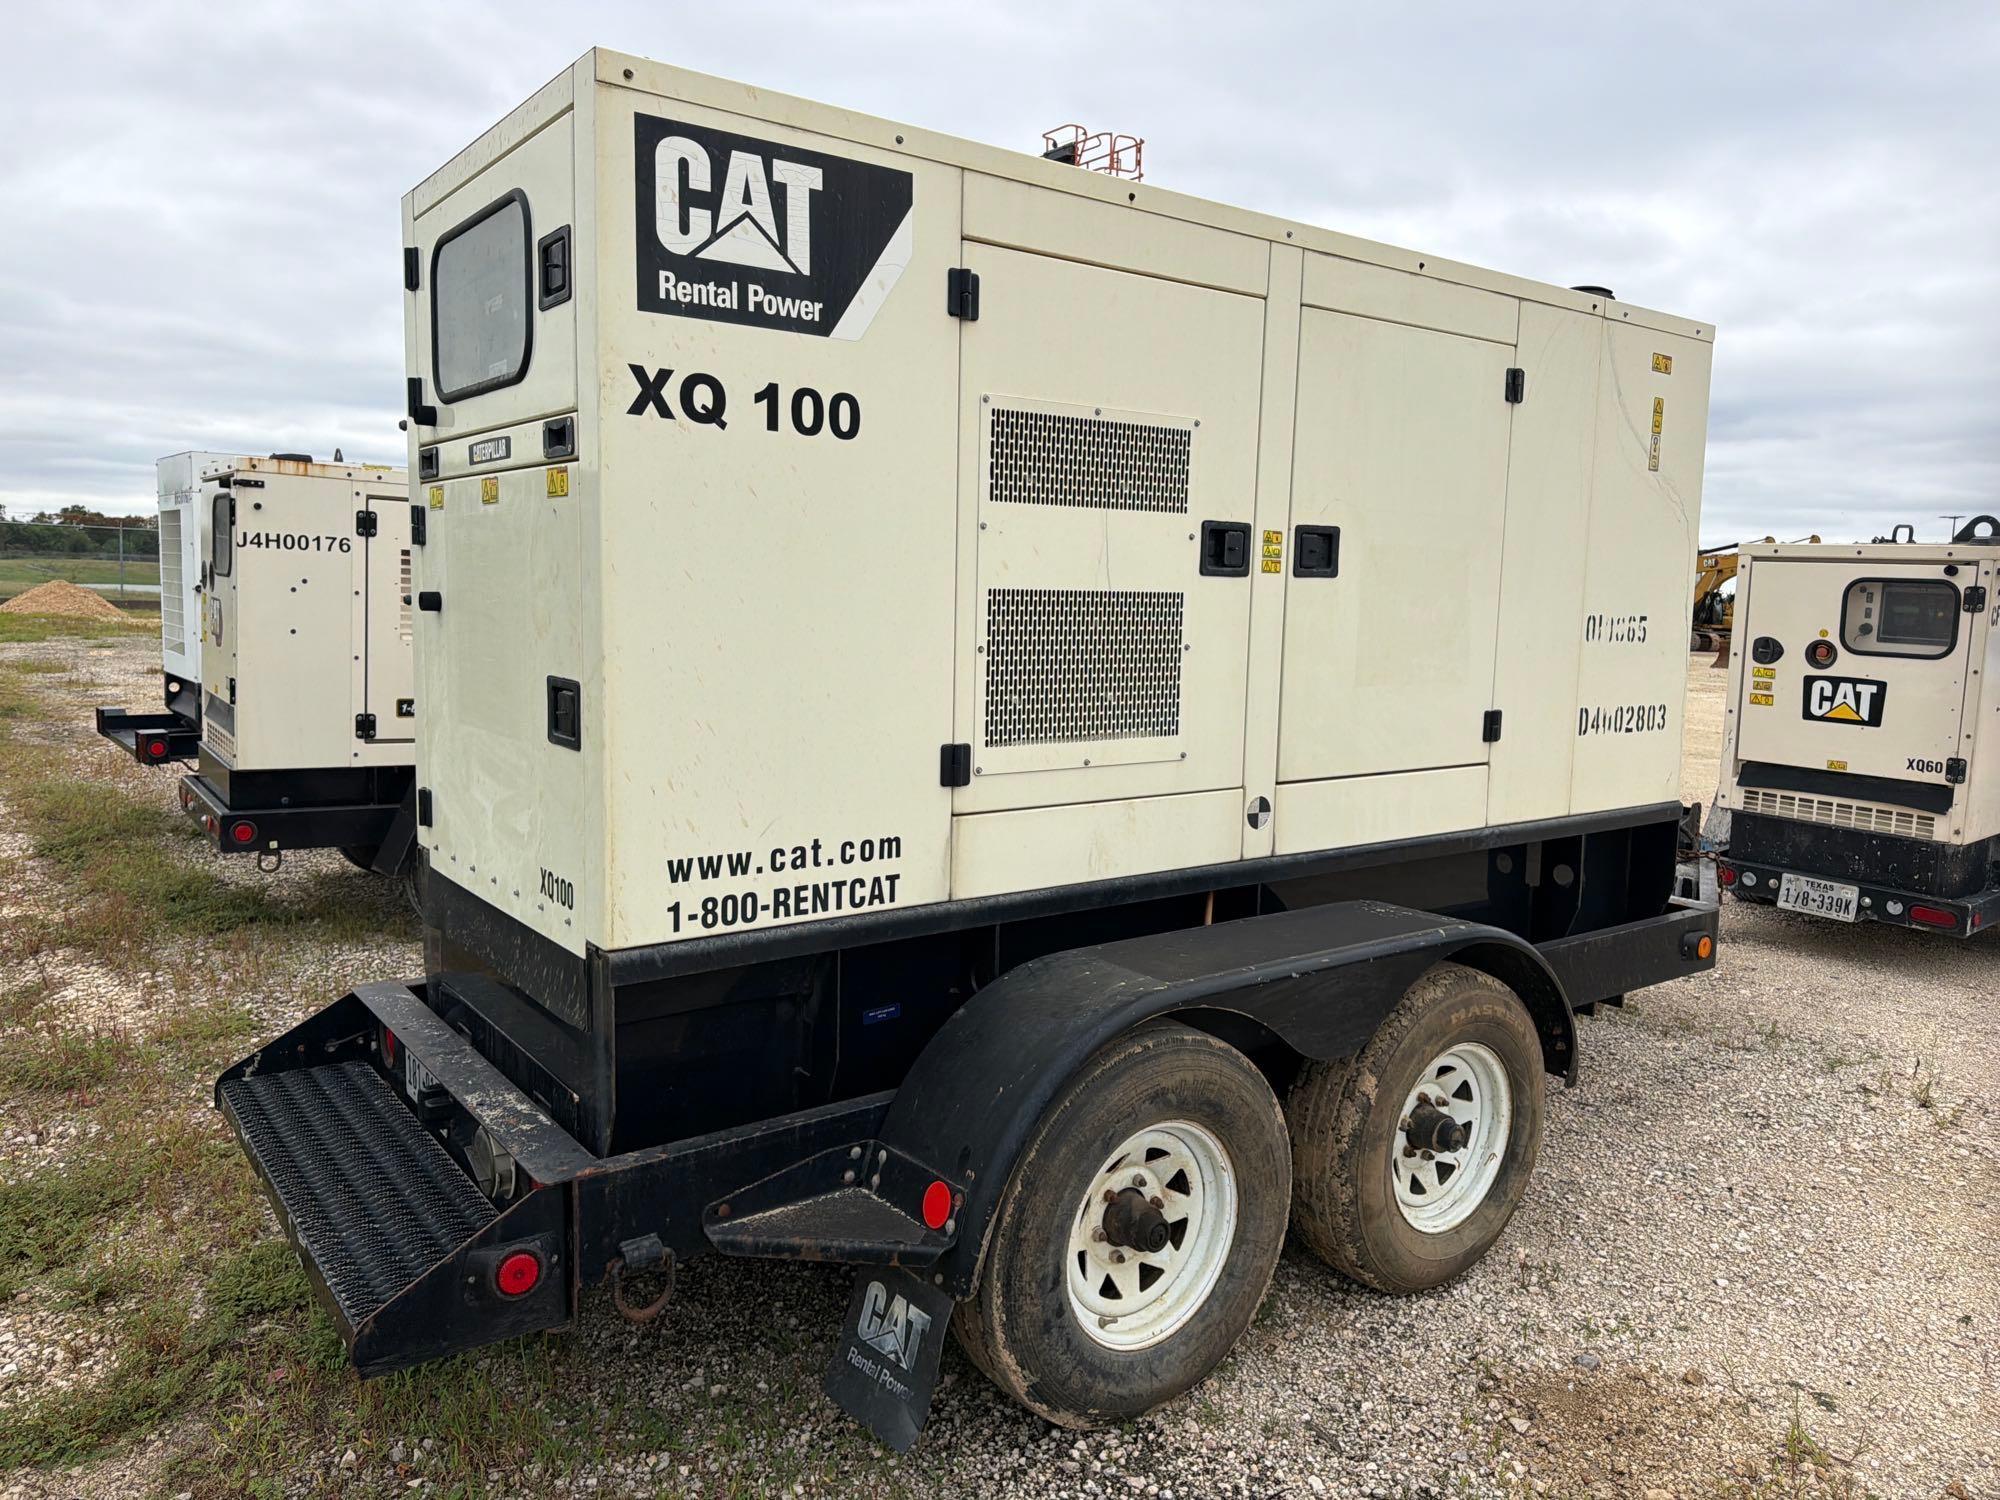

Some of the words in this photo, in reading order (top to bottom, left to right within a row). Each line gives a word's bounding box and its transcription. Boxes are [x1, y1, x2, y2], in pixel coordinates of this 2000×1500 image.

[655, 136, 823, 276] CAT
[659, 270, 738, 310] Rental
[748, 284, 823, 322] Power
[626, 363, 728, 431] XQ
[754, 382, 861, 440] 100
[236, 531, 351, 553] J4H00176
[1810, 679, 1878, 722] CAT
[1906, 758, 1944, 774] XQ60
[667, 835, 902, 884] www.cat.com
[539, 867, 574, 911] XQ100
[667, 873, 901, 933] 1-800-RENTCAT
[1805, 880, 1834, 892] TEXAS
[857, 1281, 932, 1373] CAT
[847, 1346, 881, 1380] Rental
[879, 1369, 915, 1401] Power
